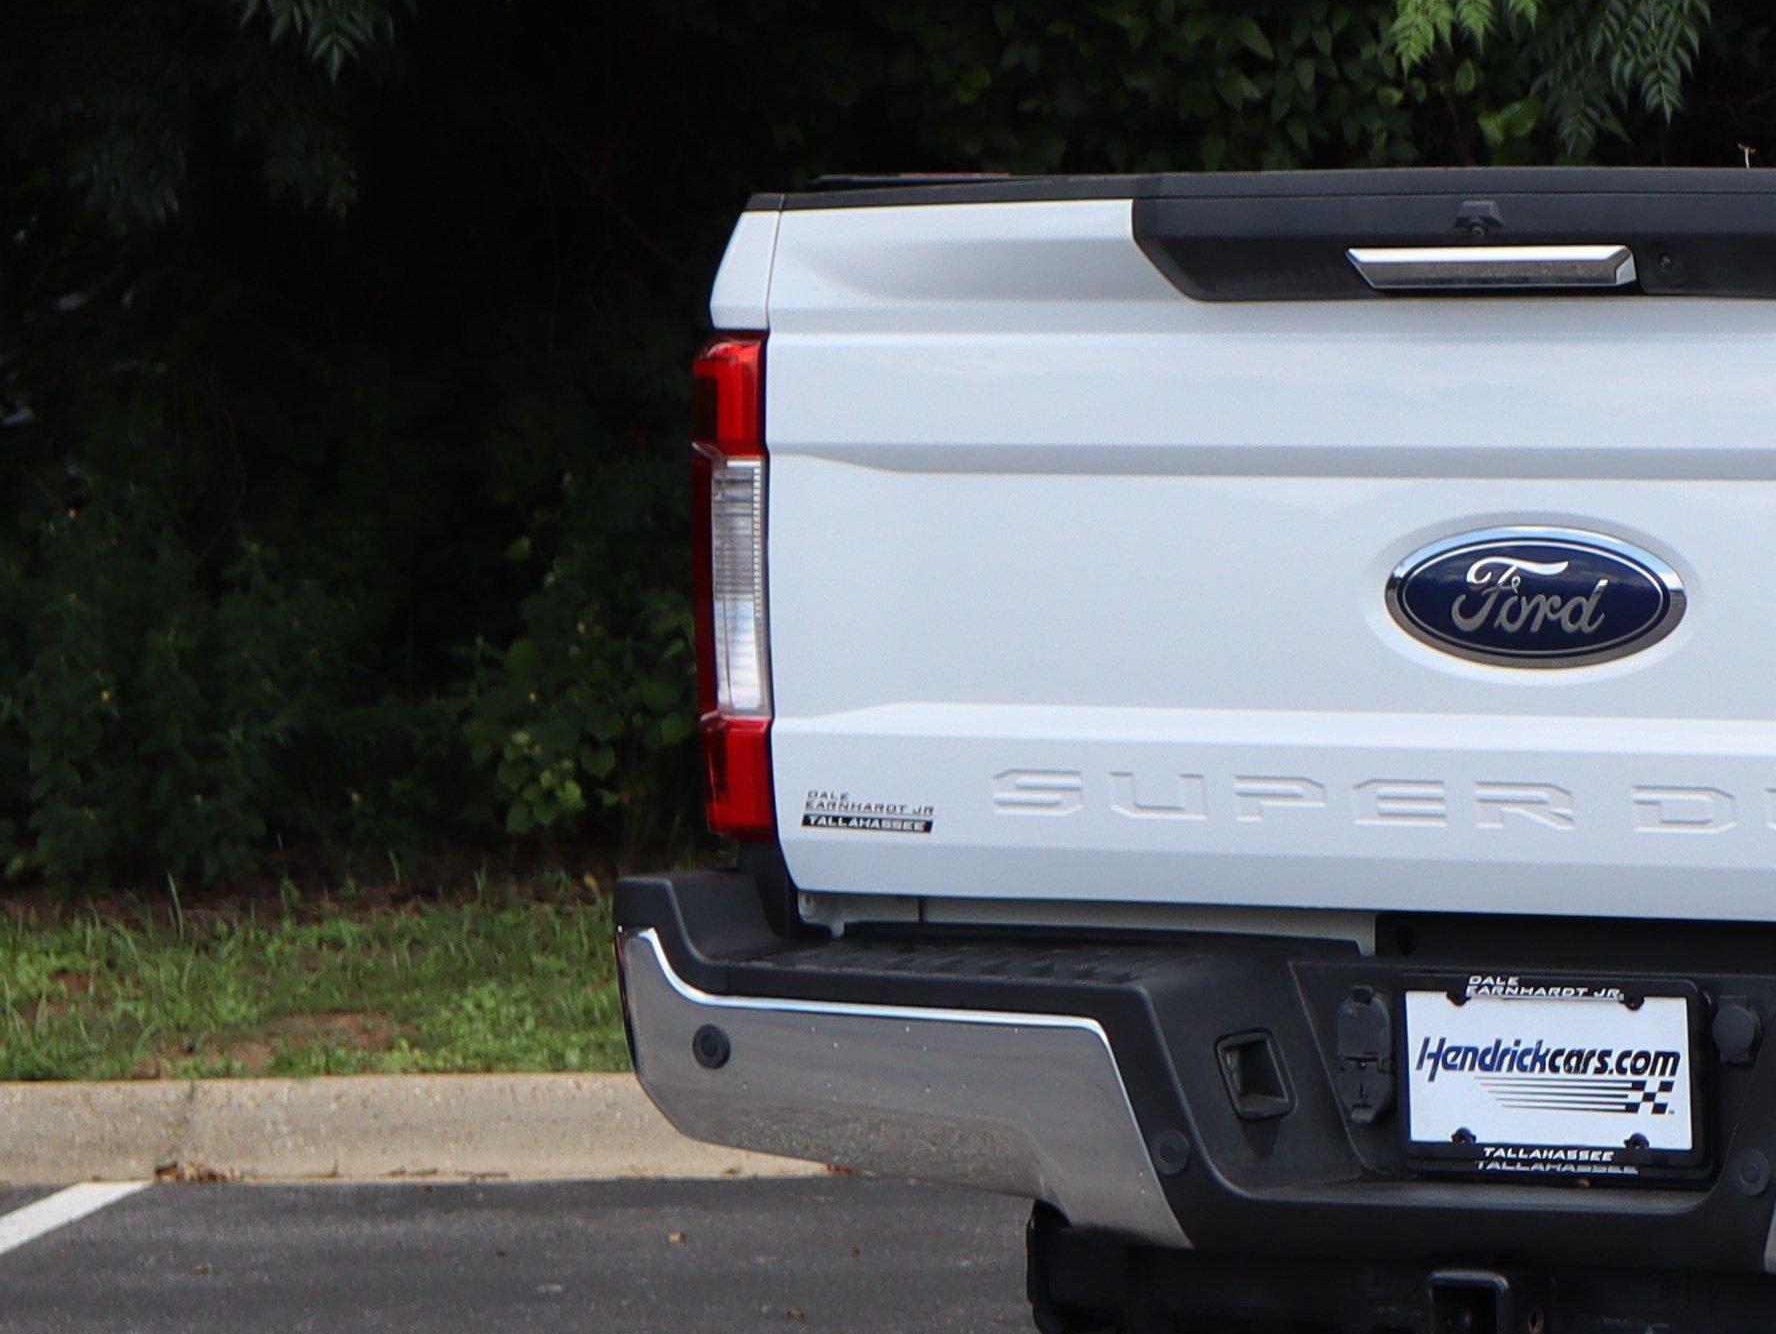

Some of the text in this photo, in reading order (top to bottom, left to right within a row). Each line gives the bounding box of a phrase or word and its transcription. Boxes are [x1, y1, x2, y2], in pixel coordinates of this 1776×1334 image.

[1451, 555, 1610, 634] Ford
[807, 790, 849, 801] DALE
[990, 768, 1575, 832] SUPER
[808, 815, 927, 831] TALLAHASSEE
[1468, 975, 1519, 986] DALE
[1465, 985, 1589, 998] EARNHARDT
[1415, 1036, 1681, 1082] Hendrickcars.com
[1483, 1147, 1615, 1162] TALLAHASSEE
